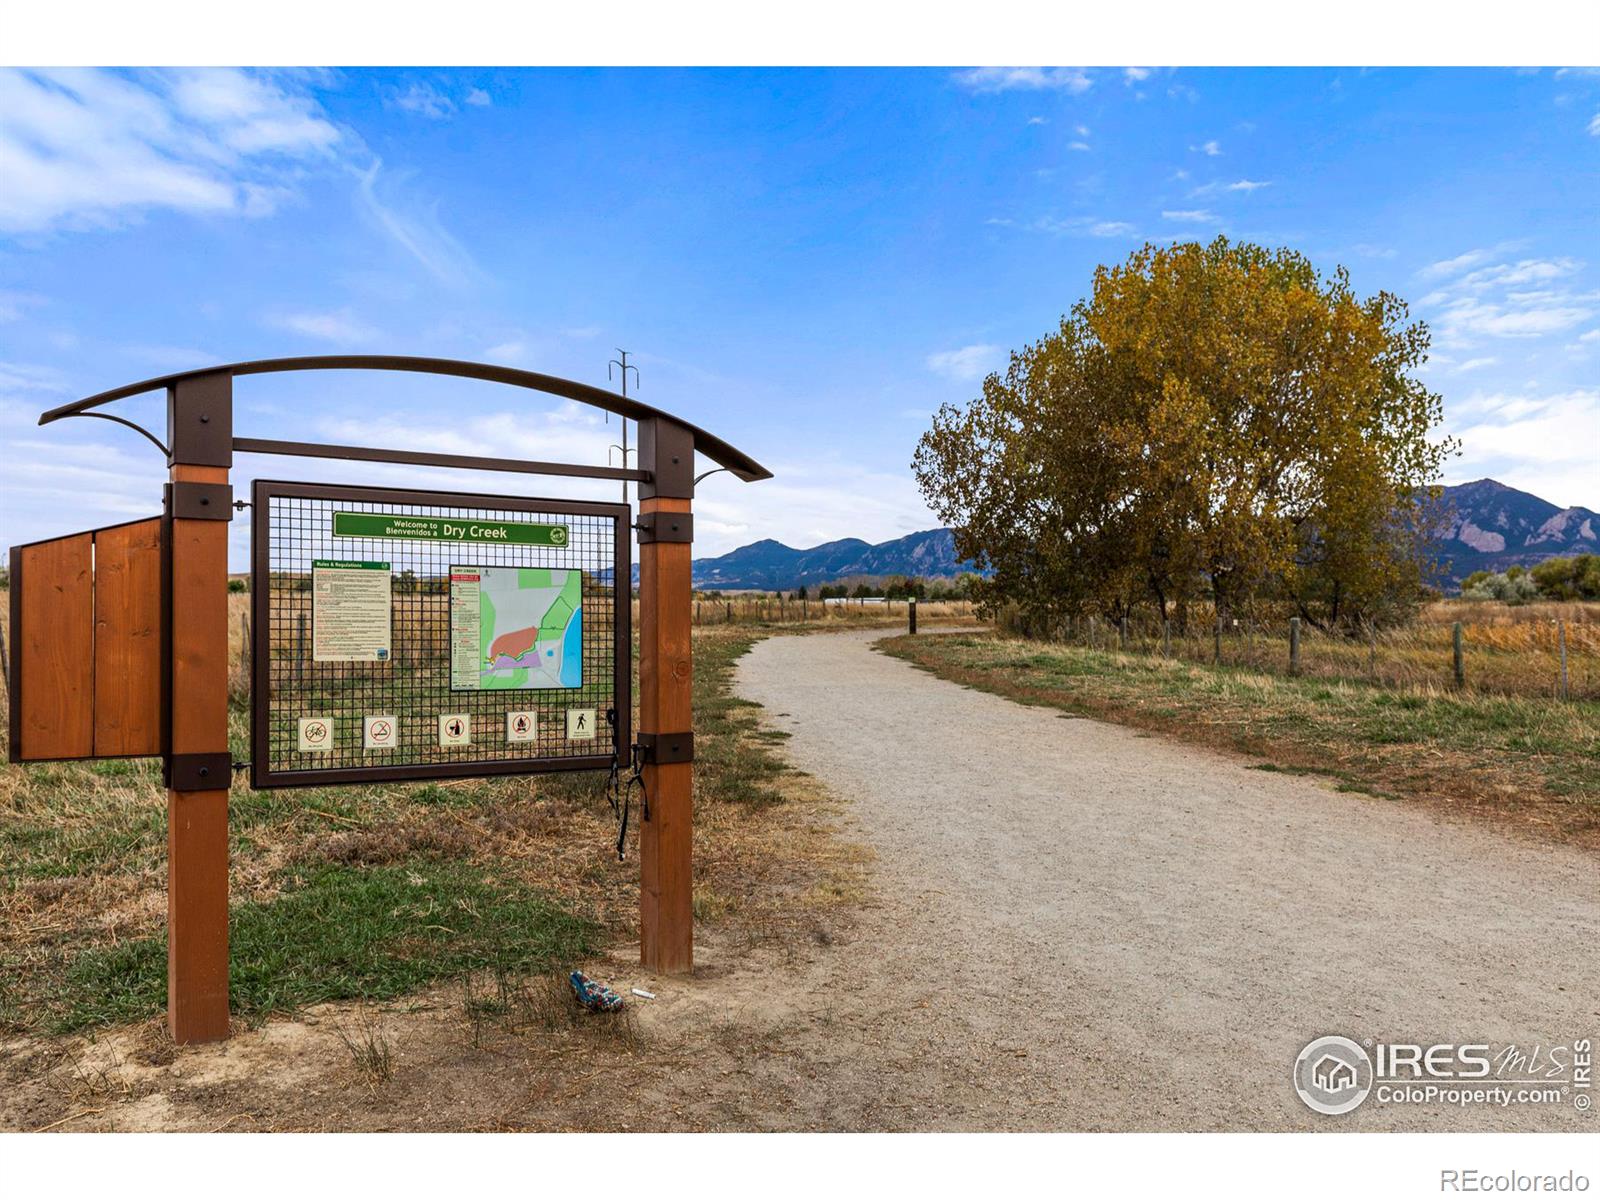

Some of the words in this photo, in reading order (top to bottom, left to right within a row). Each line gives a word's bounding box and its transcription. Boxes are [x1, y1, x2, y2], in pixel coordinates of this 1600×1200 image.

[393, 520, 428, 529] Welcome
[385, 526, 432, 537] Bienvenidos
[443, 524, 466, 539] Dry
[470, 525, 507, 539] Creek
